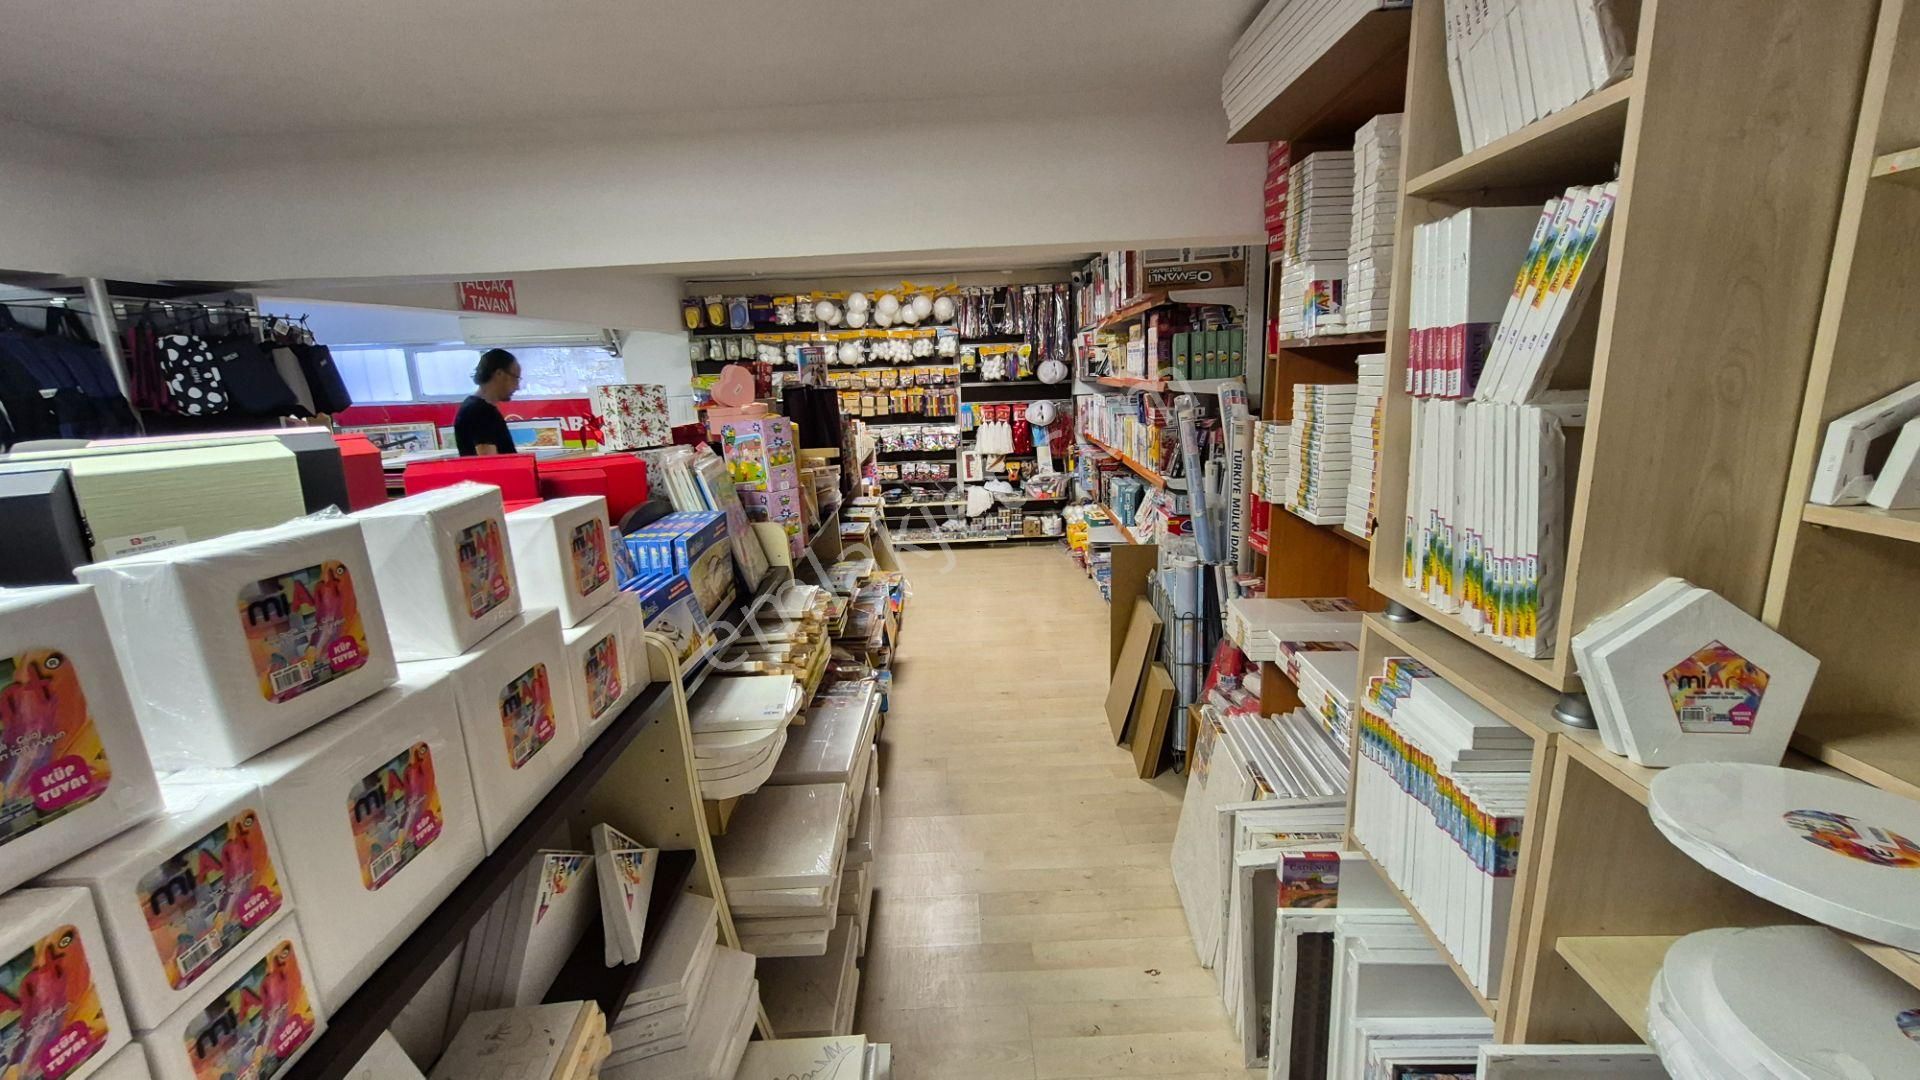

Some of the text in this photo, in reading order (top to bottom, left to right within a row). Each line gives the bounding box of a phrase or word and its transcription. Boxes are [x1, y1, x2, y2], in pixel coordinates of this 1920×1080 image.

[1148, 271, 1212, 283] OSMANLI
[470, 295, 509, 313] TAVAN
[1232, 449, 1246, 494] TÜRKİYE
[1231, 498, 1244, 532] MÜLKİ
[38, 774, 89, 803] TUVAL
[41, 764, 76, 788] KÜP
